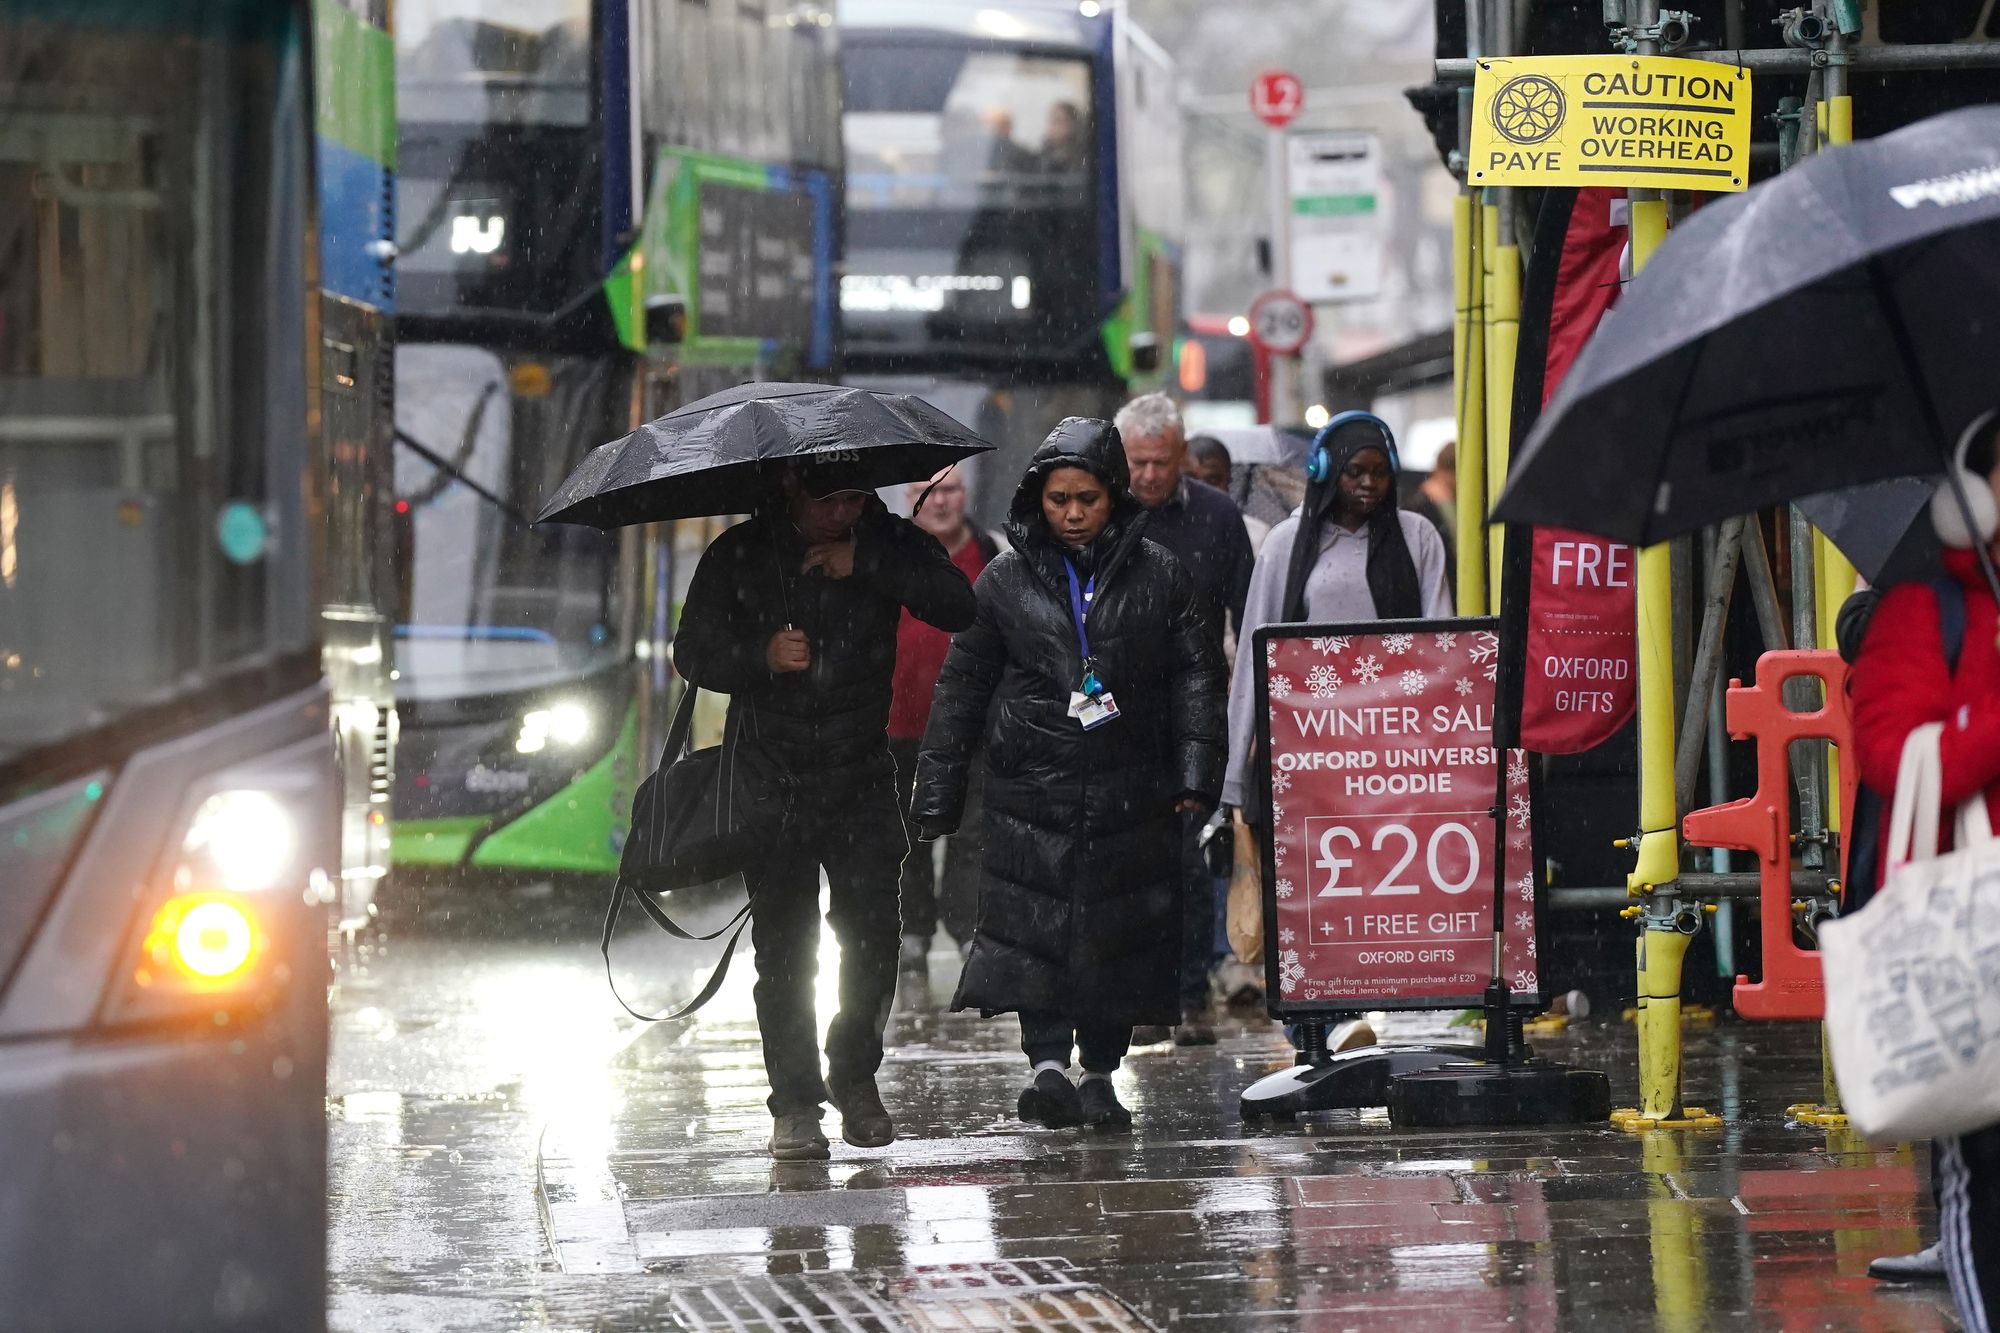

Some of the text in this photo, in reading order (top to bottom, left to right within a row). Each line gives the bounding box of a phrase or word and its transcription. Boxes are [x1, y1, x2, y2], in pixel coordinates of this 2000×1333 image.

[1253, 77, 1299, 118] L2
[1583, 72, 1734, 101] CAUTION
[1592, 116, 1724, 140] WORKING
[1489, 151, 1562, 171] PAYE
[1580, 138, 1734, 162] OVERHEAD
[815, 449, 861, 465] BOSS
[1552, 542, 1635, 587] FRE
[1544, 655, 1628, 680] OXFORD
[1555, 690, 1614, 713] GIFTS
[1292, 703, 1495, 738] WINTER SAL
[1277, 746, 1525, 772] OXFORD UNIVERSIY
[1345, 772, 1452, 796] HOODIE
[1315, 822, 1480, 897] £20
[1320, 921, 1335, 936] +
[1343, 915, 1353, 936] 1
[1363, 913, 1419, 935] FREE
[1358, 949, 1455, 965] OXFORD GIFTS
[1323, 987, 1356, 995] selected
[1358, 986, 1379, 995] items
[1381, 986, 1398, 995] only
[1328, 977, 1342, 988] gift
[1343, 977, 1363, 986] from
[1371, 976, 1407, 985] minimum
[1410, 975, 1447, 986] purchase
[1449, 974, 1457, 983] of
[1459, 974, 1476, 983] £20
